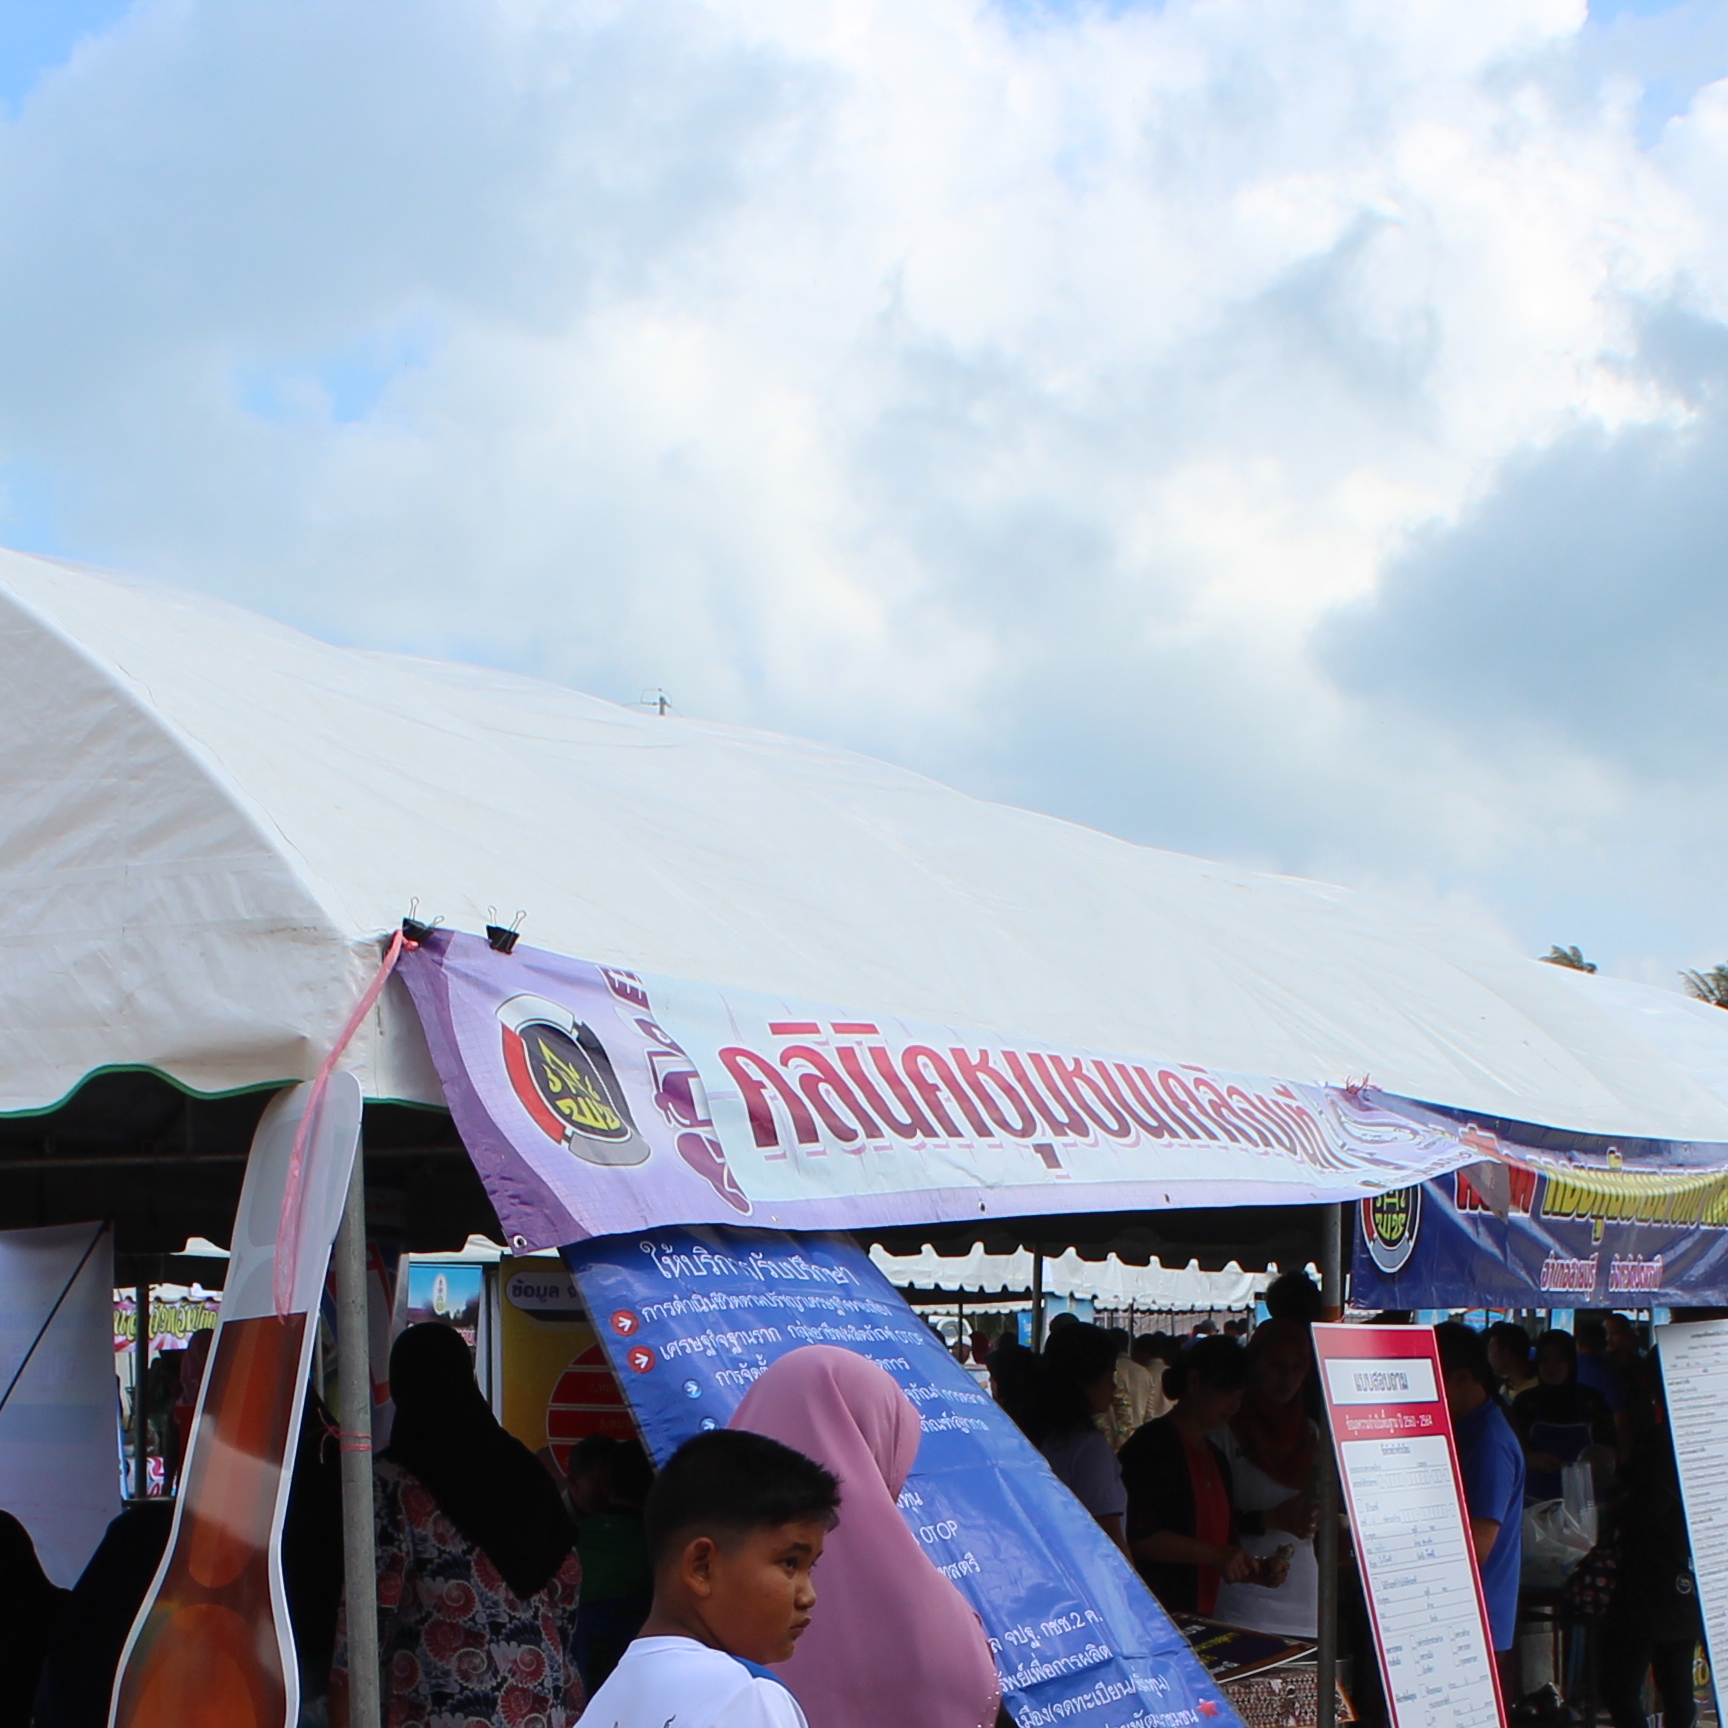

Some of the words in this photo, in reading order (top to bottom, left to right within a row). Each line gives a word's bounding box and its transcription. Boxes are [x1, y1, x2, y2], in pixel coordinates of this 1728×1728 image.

[1352, 1371, 1409, 1394] แบบสอบถาม
[922, 1519, 959, 1546] OTOP
